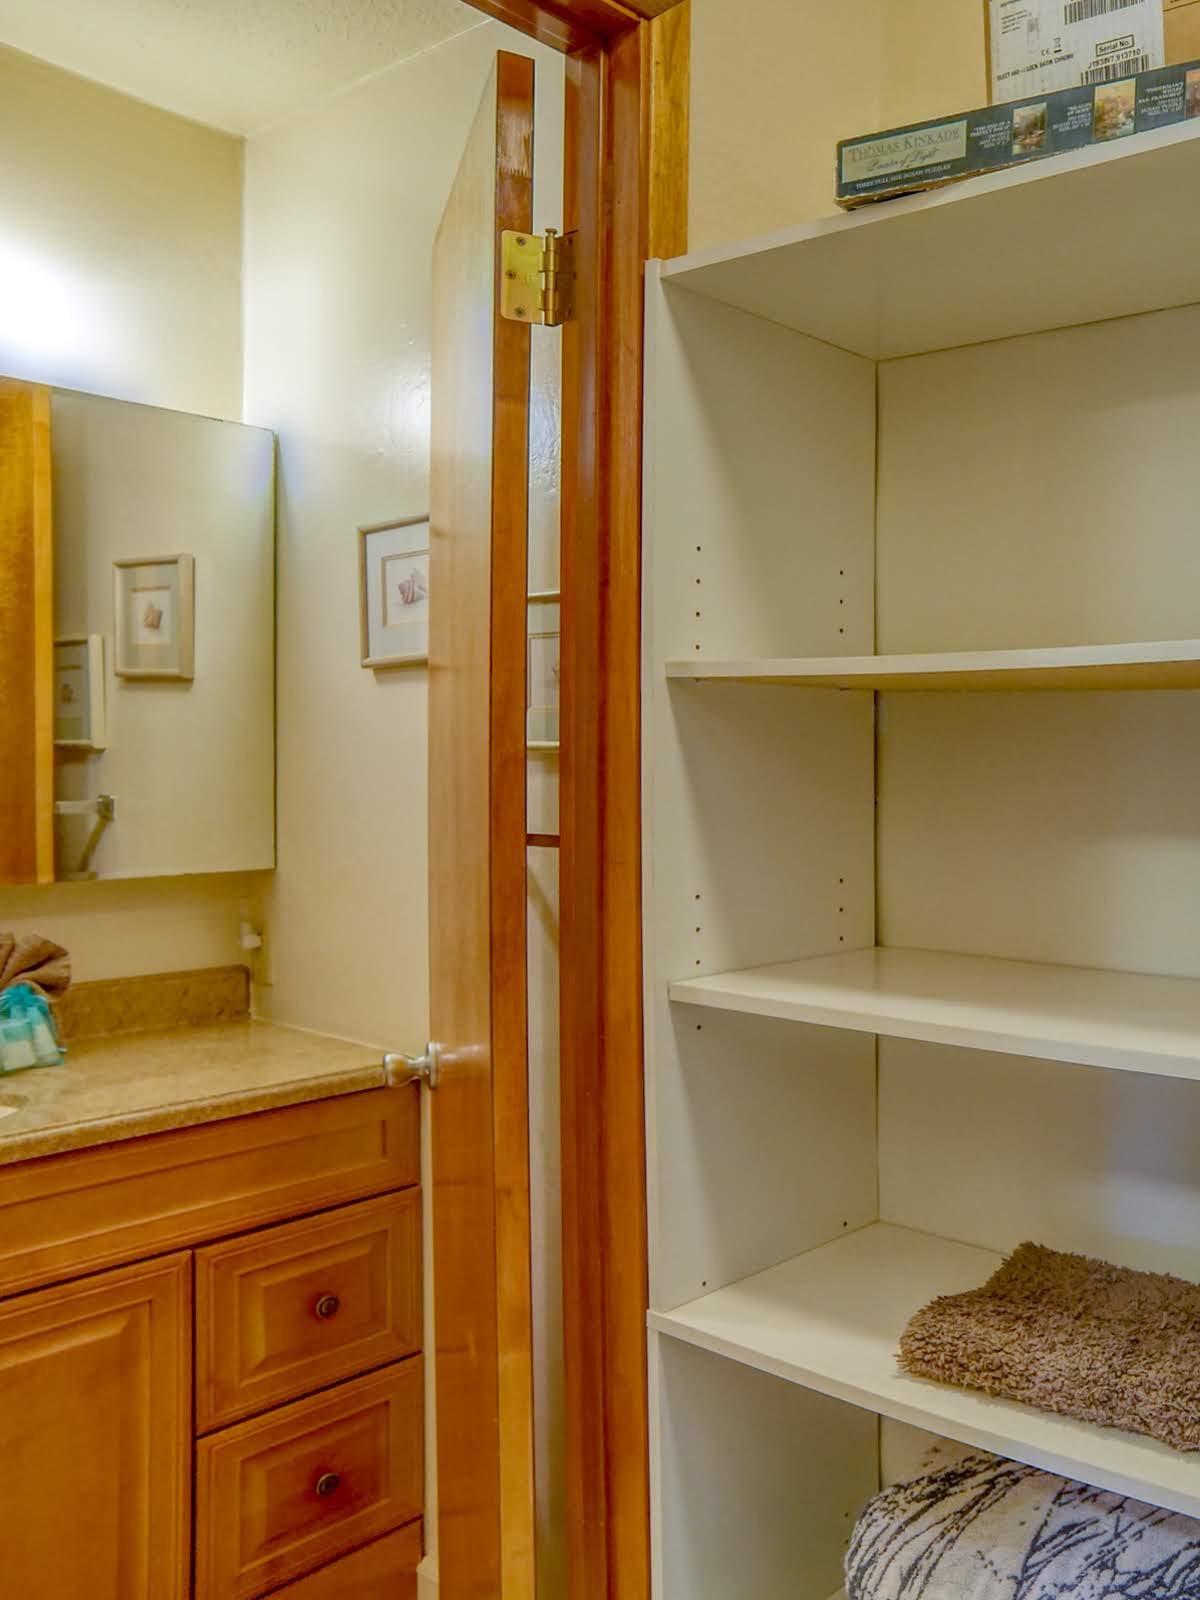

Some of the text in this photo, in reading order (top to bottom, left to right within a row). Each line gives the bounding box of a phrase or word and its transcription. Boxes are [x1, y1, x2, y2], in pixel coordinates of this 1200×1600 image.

[1099, 40, 1131, 53] Serial No.
[848, 143, 902, 162] THOMAS
[903, 128, 960, 151] KINKADE
